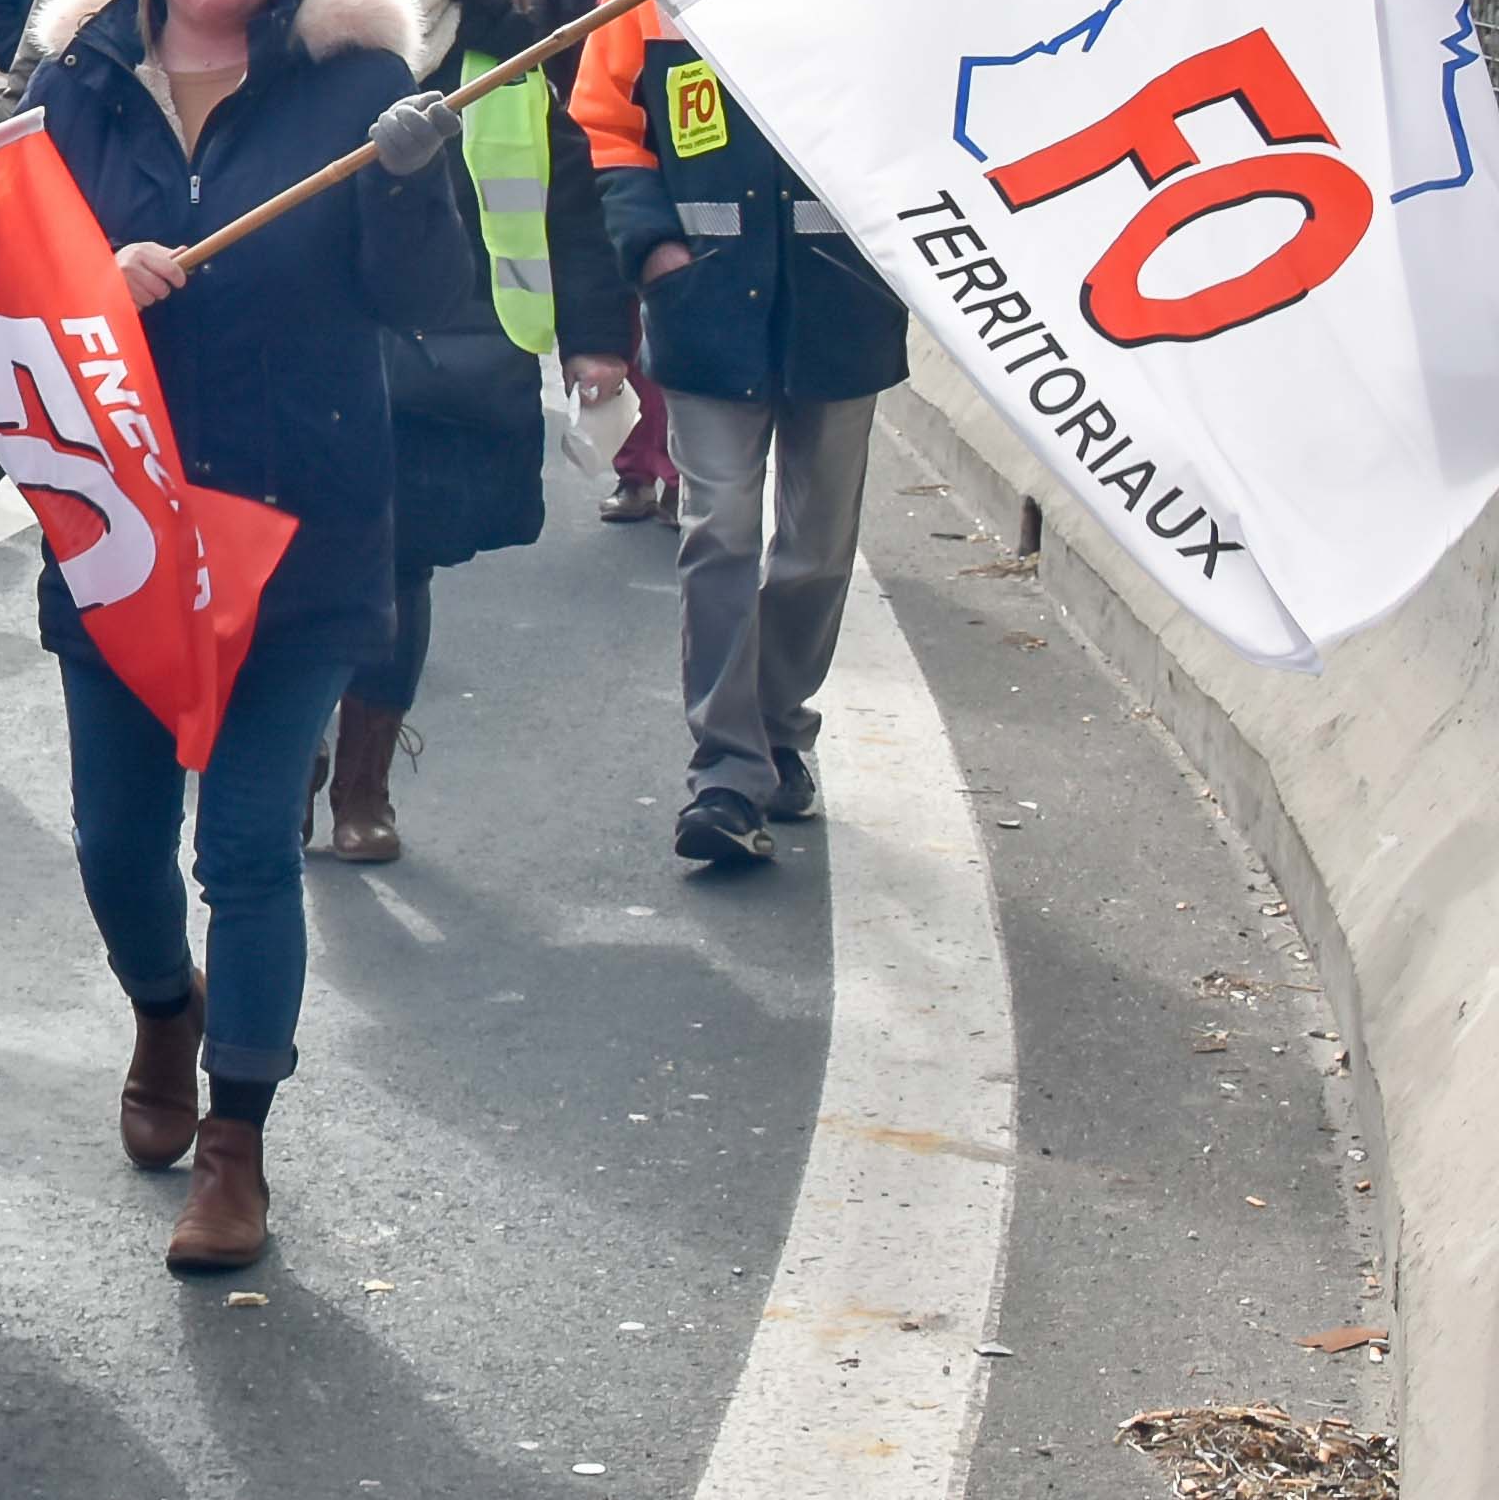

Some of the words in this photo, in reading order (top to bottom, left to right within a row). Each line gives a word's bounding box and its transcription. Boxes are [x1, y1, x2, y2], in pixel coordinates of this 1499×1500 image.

[679, 78, 715, 129] FO
[984, 26, 1375, 347] FO
[896, 189, 1245, 581] TERRITORIAUX
